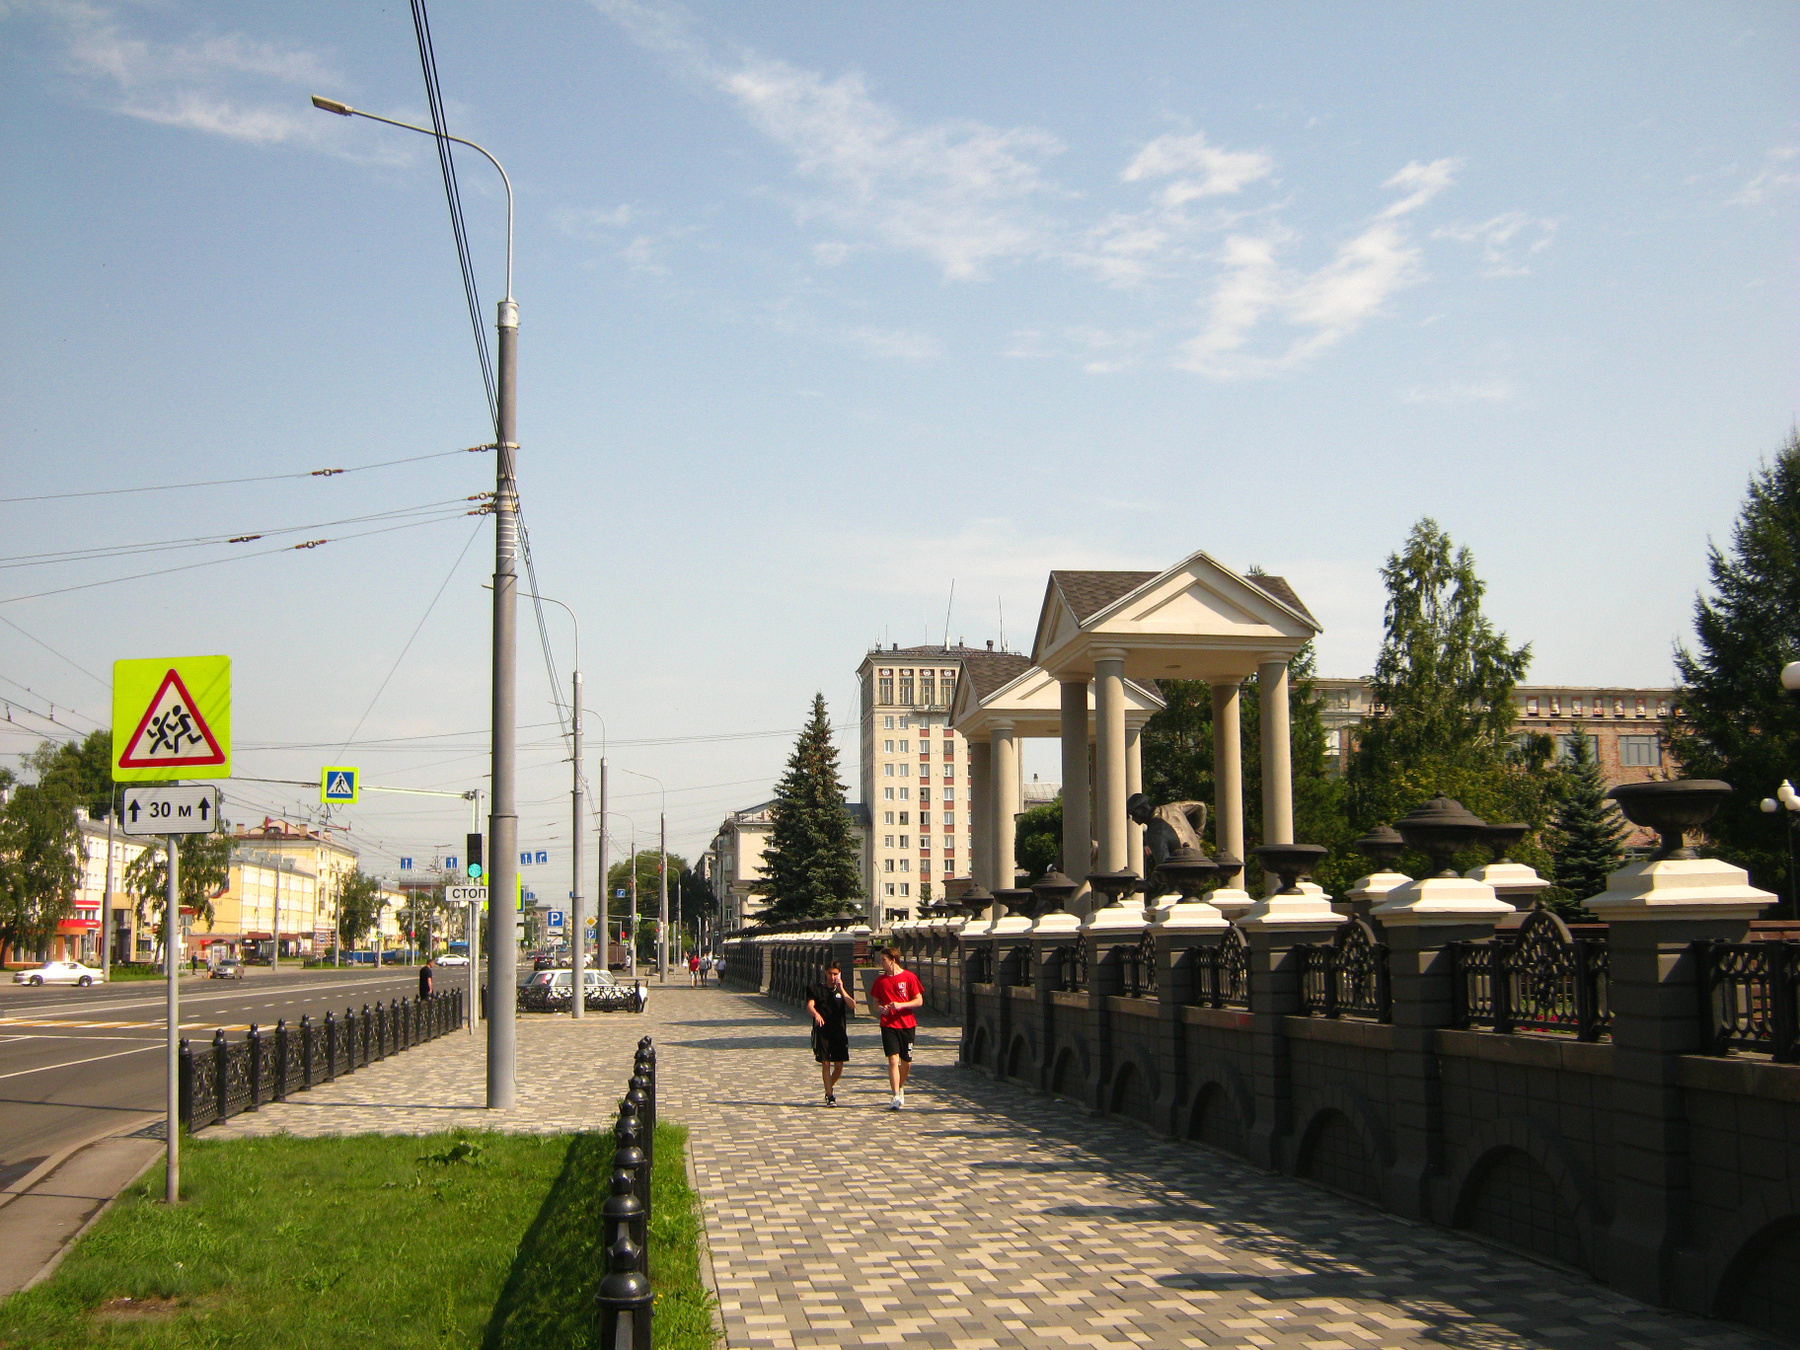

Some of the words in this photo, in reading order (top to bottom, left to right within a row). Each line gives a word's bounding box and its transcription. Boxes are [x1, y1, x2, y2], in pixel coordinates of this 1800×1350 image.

[149, 801, 172, 818] 30
[452, 888, 487, 899] СТОП
[550, 912, 560, 926] P
